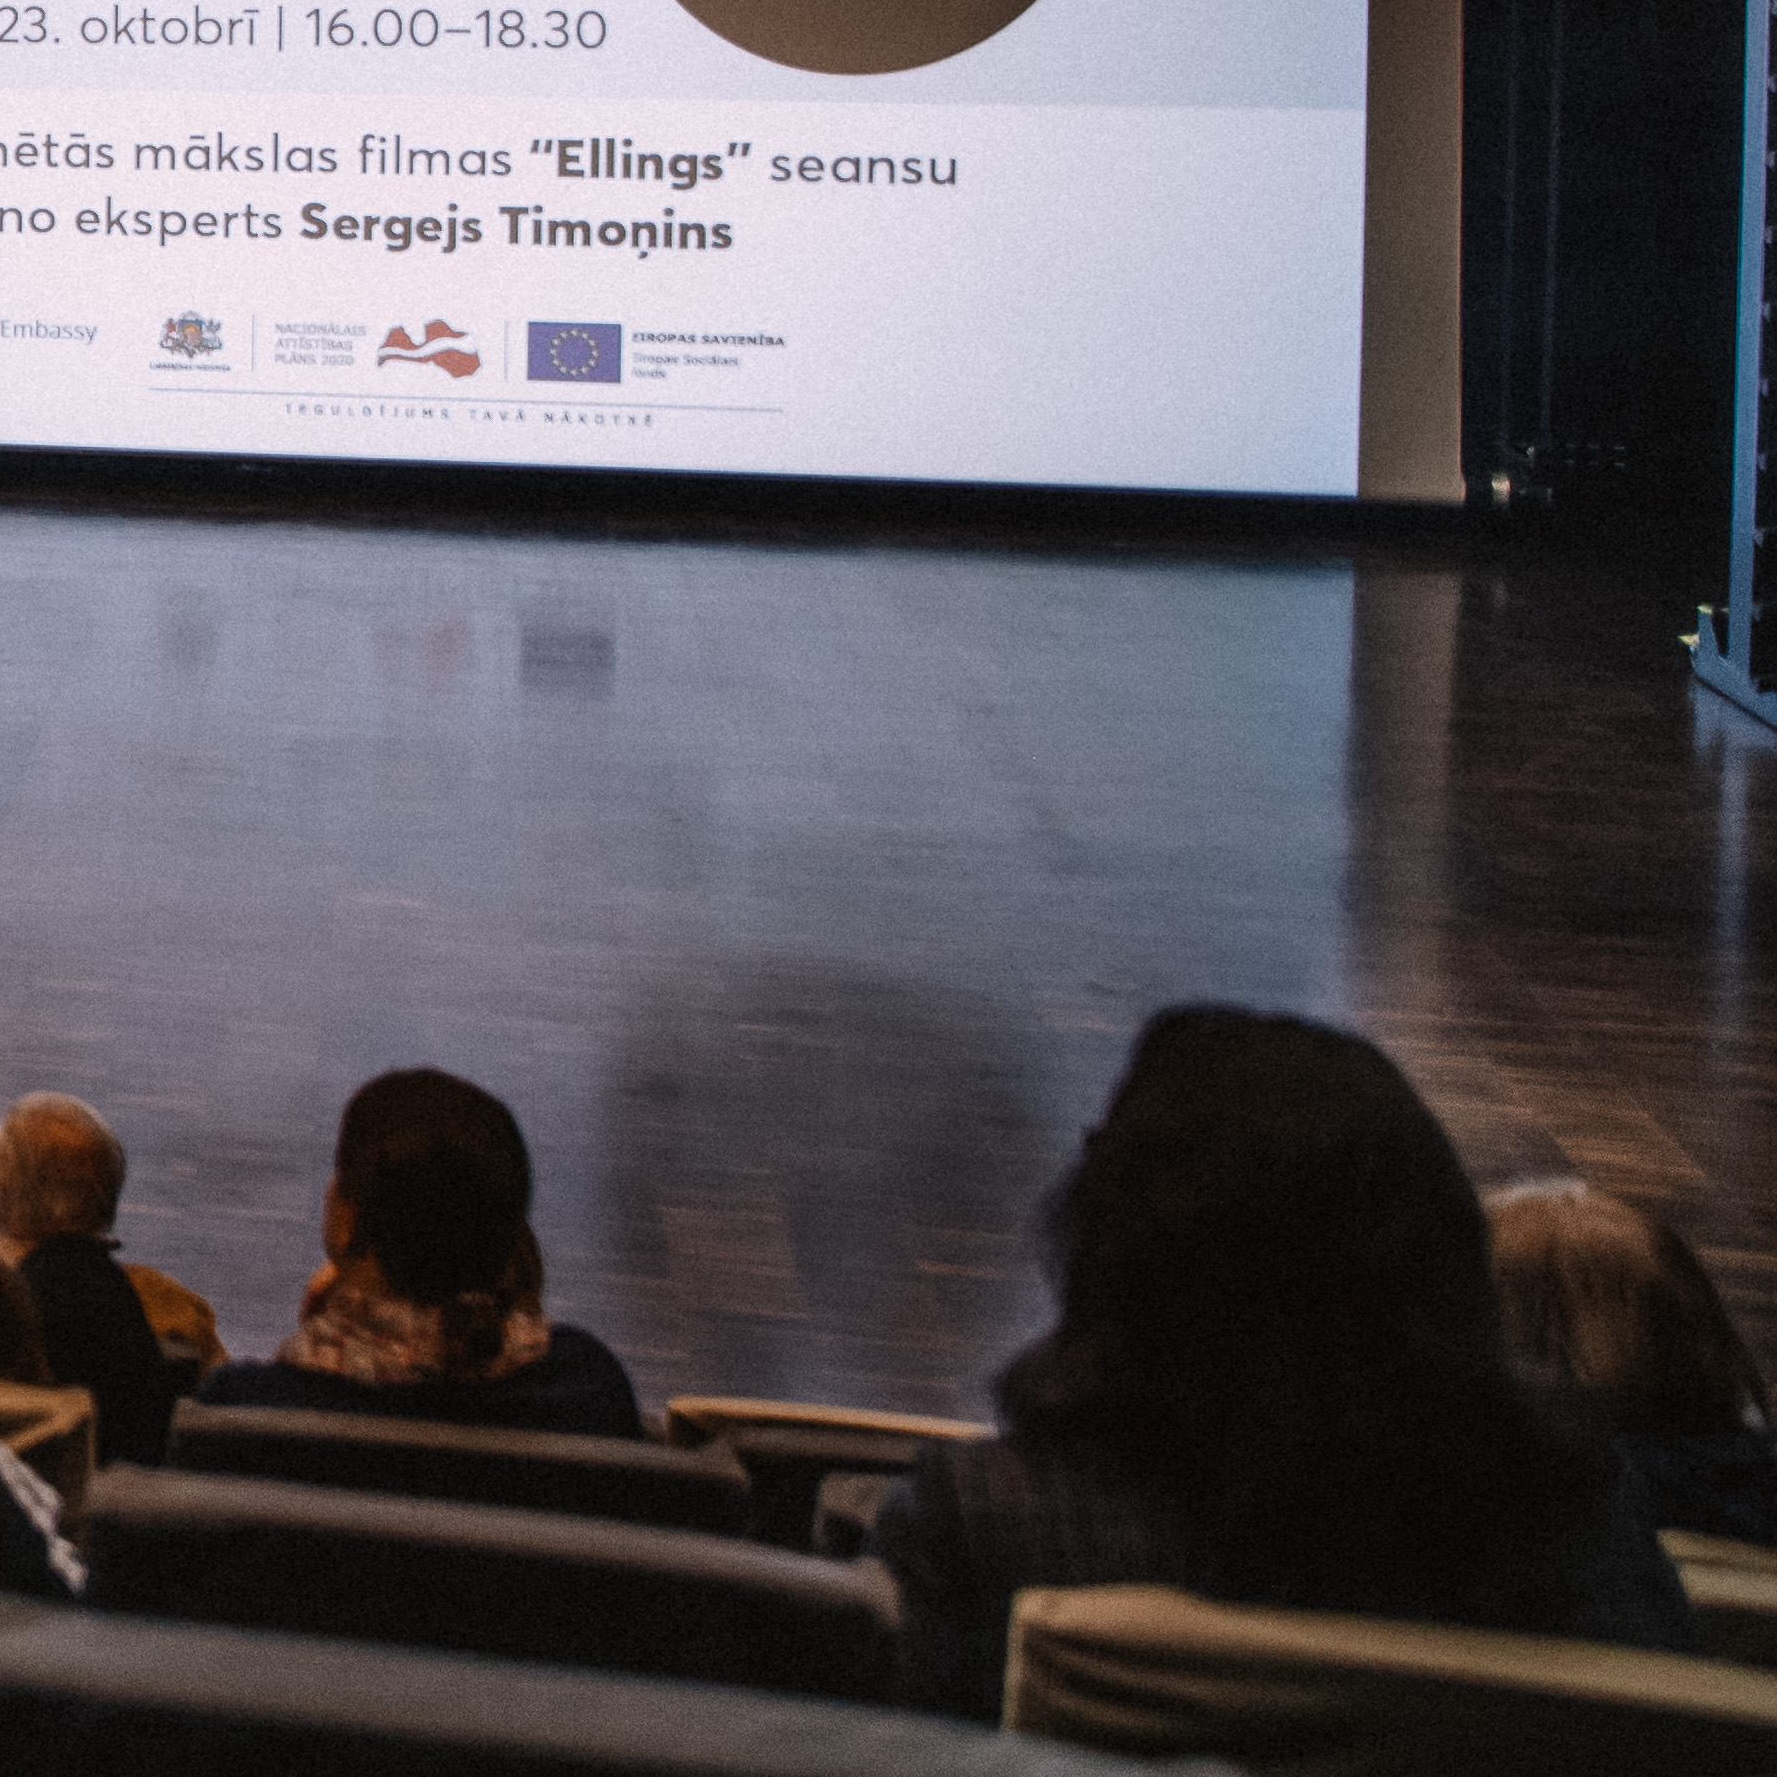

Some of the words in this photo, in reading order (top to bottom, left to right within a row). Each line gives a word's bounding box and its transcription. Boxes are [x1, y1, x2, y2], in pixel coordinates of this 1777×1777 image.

[80, 4, 260, 46] oktobrī
[305, 7, 608, 50] 16.00–18.30
[134, 131, 339, 174] mākslas
[358, 133, 513, 177] filmas
[530, 137, 752, 191] “Ellings”
[770, 154, 958, 186] seansu
[74, 196, 283, 248] eksperts
[300, 202, 483, 254] Sergejs
[499, 204, 733, 260] Timoņins
[0, 319, 99, 345] Embassy
